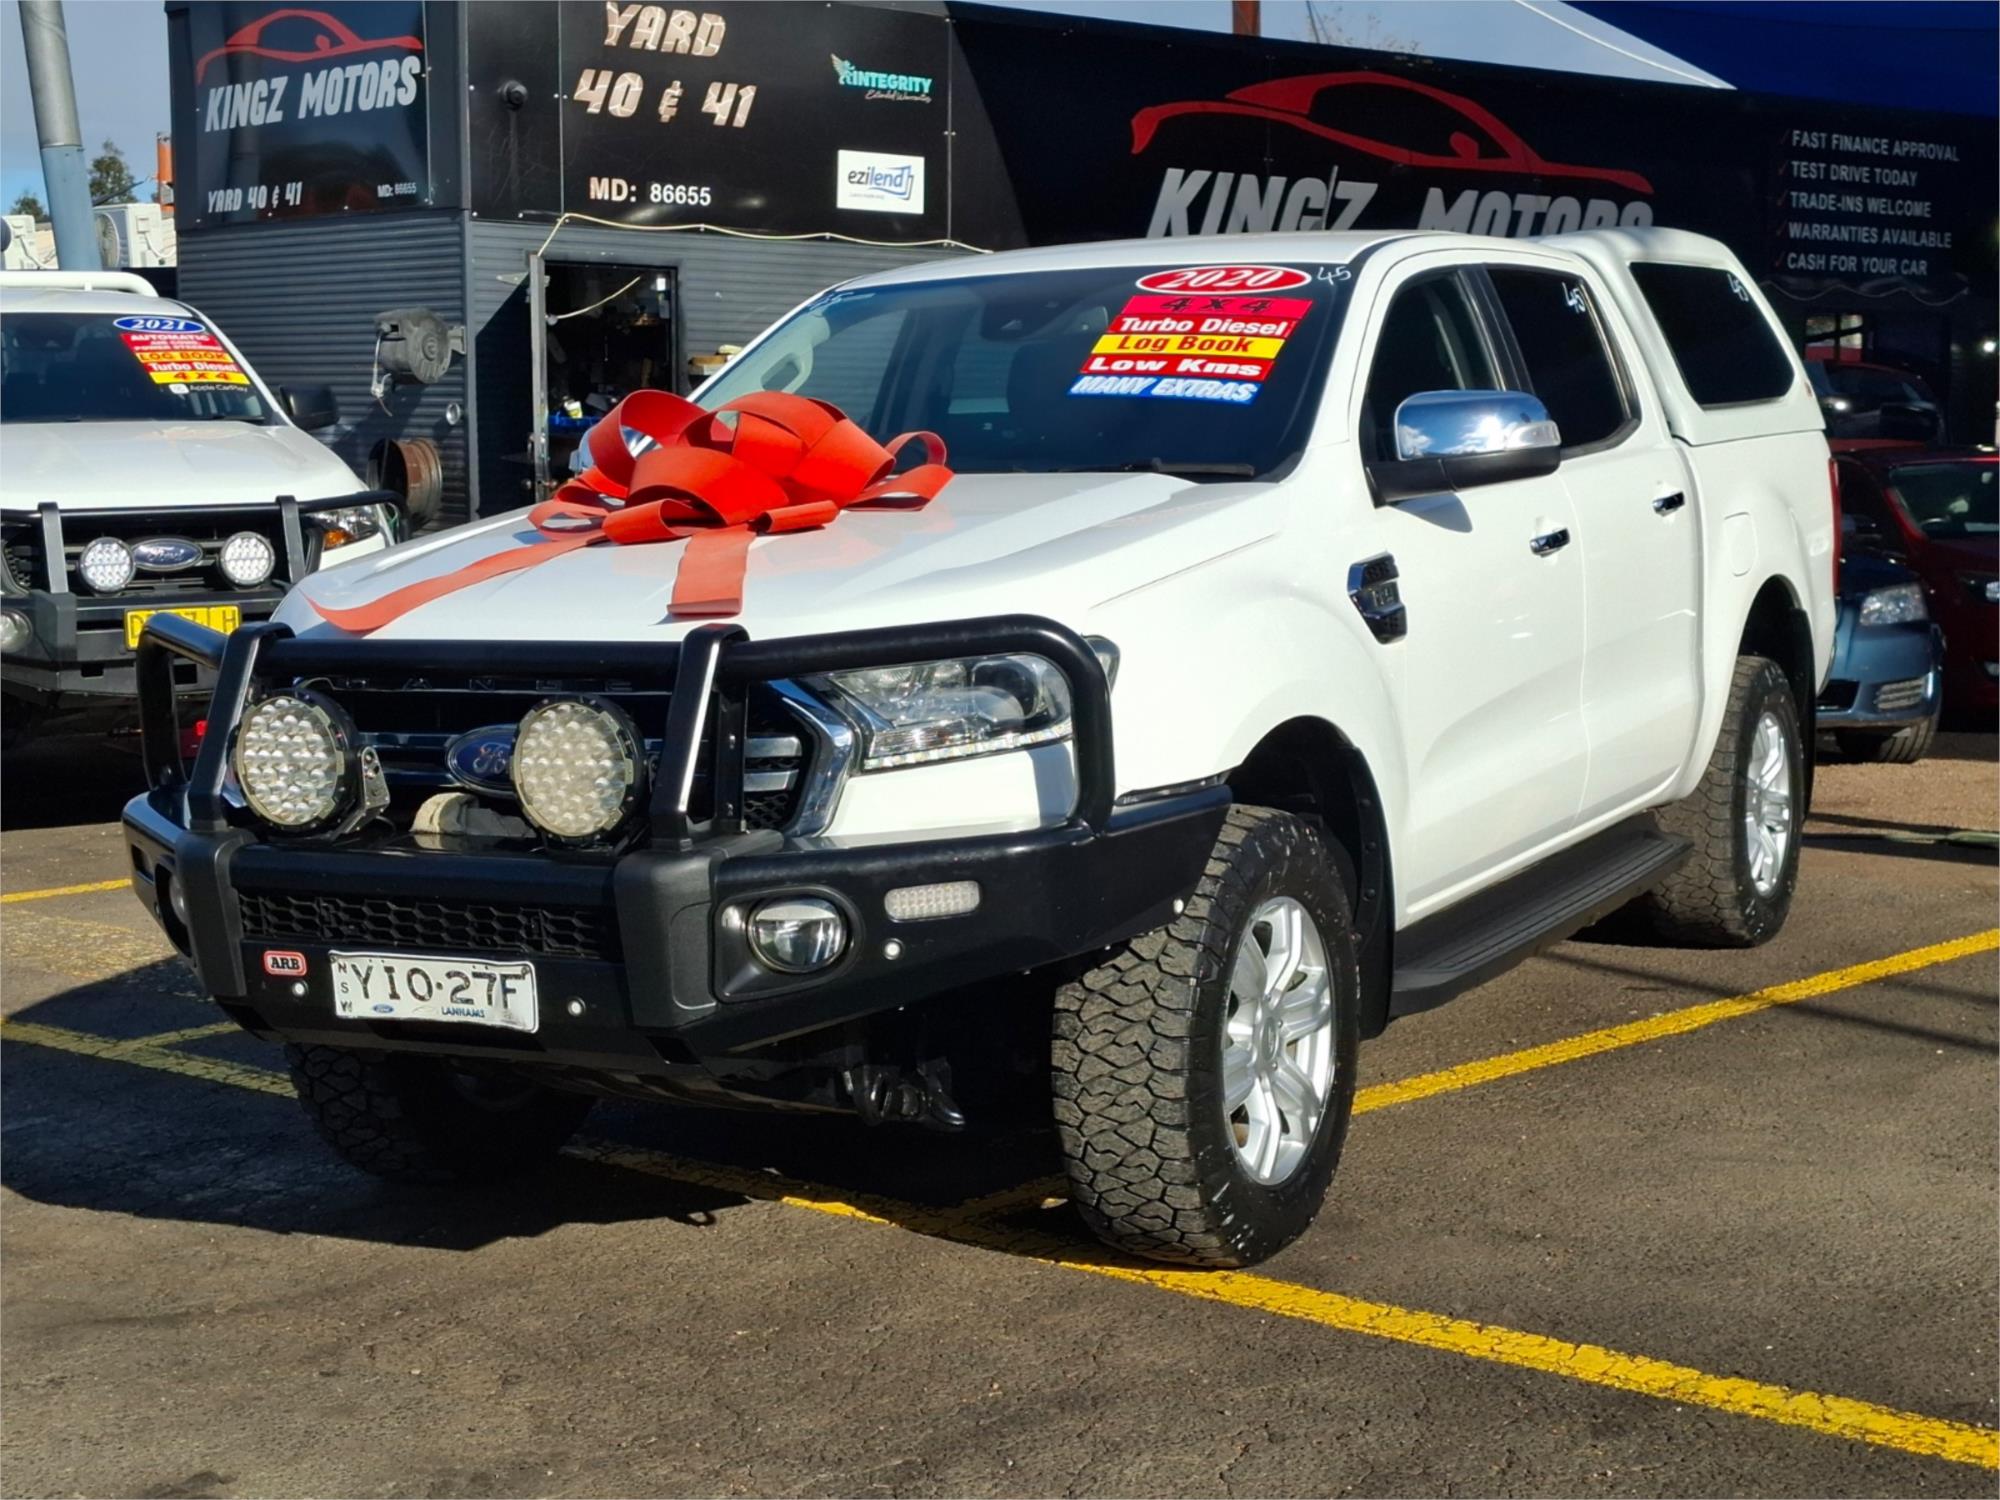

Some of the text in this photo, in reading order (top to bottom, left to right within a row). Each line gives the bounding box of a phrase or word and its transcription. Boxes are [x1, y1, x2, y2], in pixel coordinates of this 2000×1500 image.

[604, 1, 726, 57] YARD
[853, 70, 932, 93] INTEGRITY
[205, 55, 421, 132] KINGZ MOTORS
[574, 69, 644, 118] 40
[702, 82, 757, 128] 41
[1792, 130, 1960, 162] FAST FINANCE APPROVAL
[848, 166, 910, 188] ezilend
[1791, 161, 1918, 187] TEST DRIVE TODAY
[208, 188, 242, 213] YARD
[248, 185, 267, 209] 40
[285, 182, 303, 206] 41
[590, 177, 711, 206] MD: 86655
[1146, 167, 1378, 239] KINGZ
[1790, 192, 1932, 218] TRADE-INS WELCOME
[1788, 222, 1952, 249] WARRANTIES AVAILABLE
[1787, 252, 1928, 276] CASH FOR YOUR CAR
[1157, 269, 1281, 288] 2020
[1317, 265, 1351, 287] 45
[1160, 298, 1191, 312] 4
[1242, 300, 1272, 313] 4
[131, 318, 187, 331] 2021
[1120, 317, 1288, 337] Turbo Diesel
[1117, 335, 1255, 352] Log Book
[140, 352, 226, 361] LOG BOOK
[150, 362, 237, 372] Turbo Diesel
[1089, 358, 1263, 376] Low Kms
[173, 372, 188, 381] 4
[215, 372, 230, 381] 4
[1070, 376, 1258, 401] MANY EXTRAS
[270, 953, 301, 970] ARB
